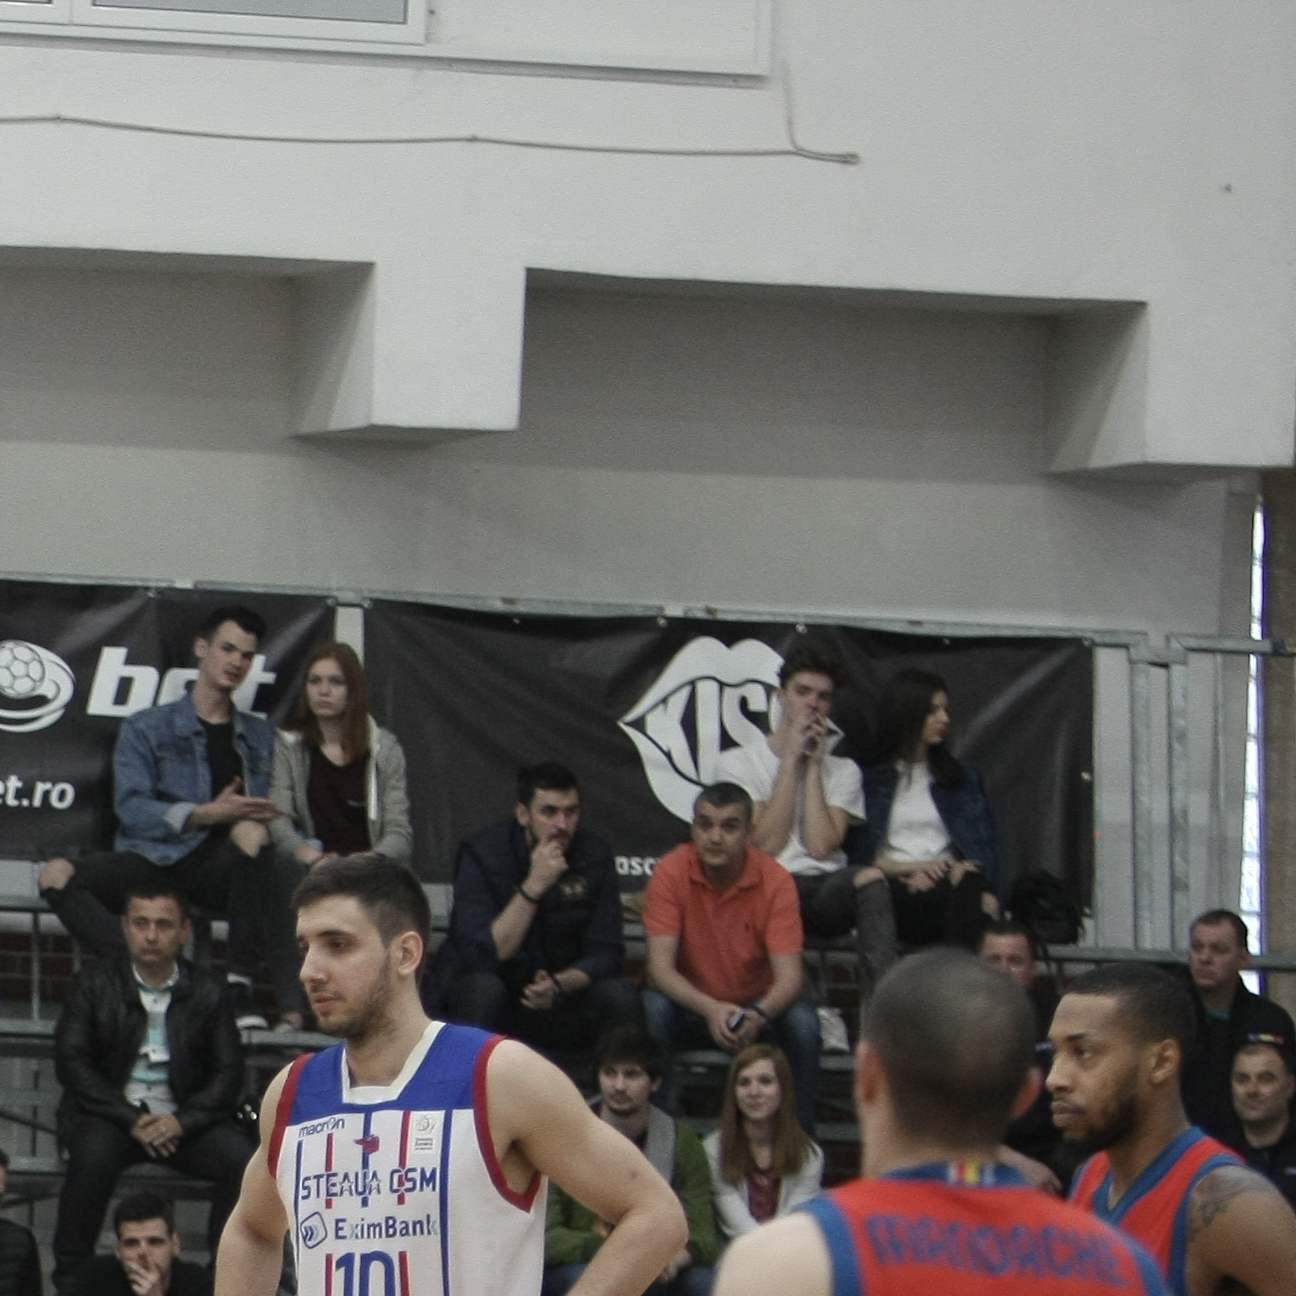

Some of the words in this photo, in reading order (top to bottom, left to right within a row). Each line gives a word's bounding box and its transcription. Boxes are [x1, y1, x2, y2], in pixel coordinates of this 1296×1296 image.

[644, 678, 784, 788] KIS
[298, 1117, 345, 1138] macron
[300, 1169, 381, 1200] STEAUA
[389, 1167, 438, 1195] CSM
[334, 1213, 439, 1241] EximBank
